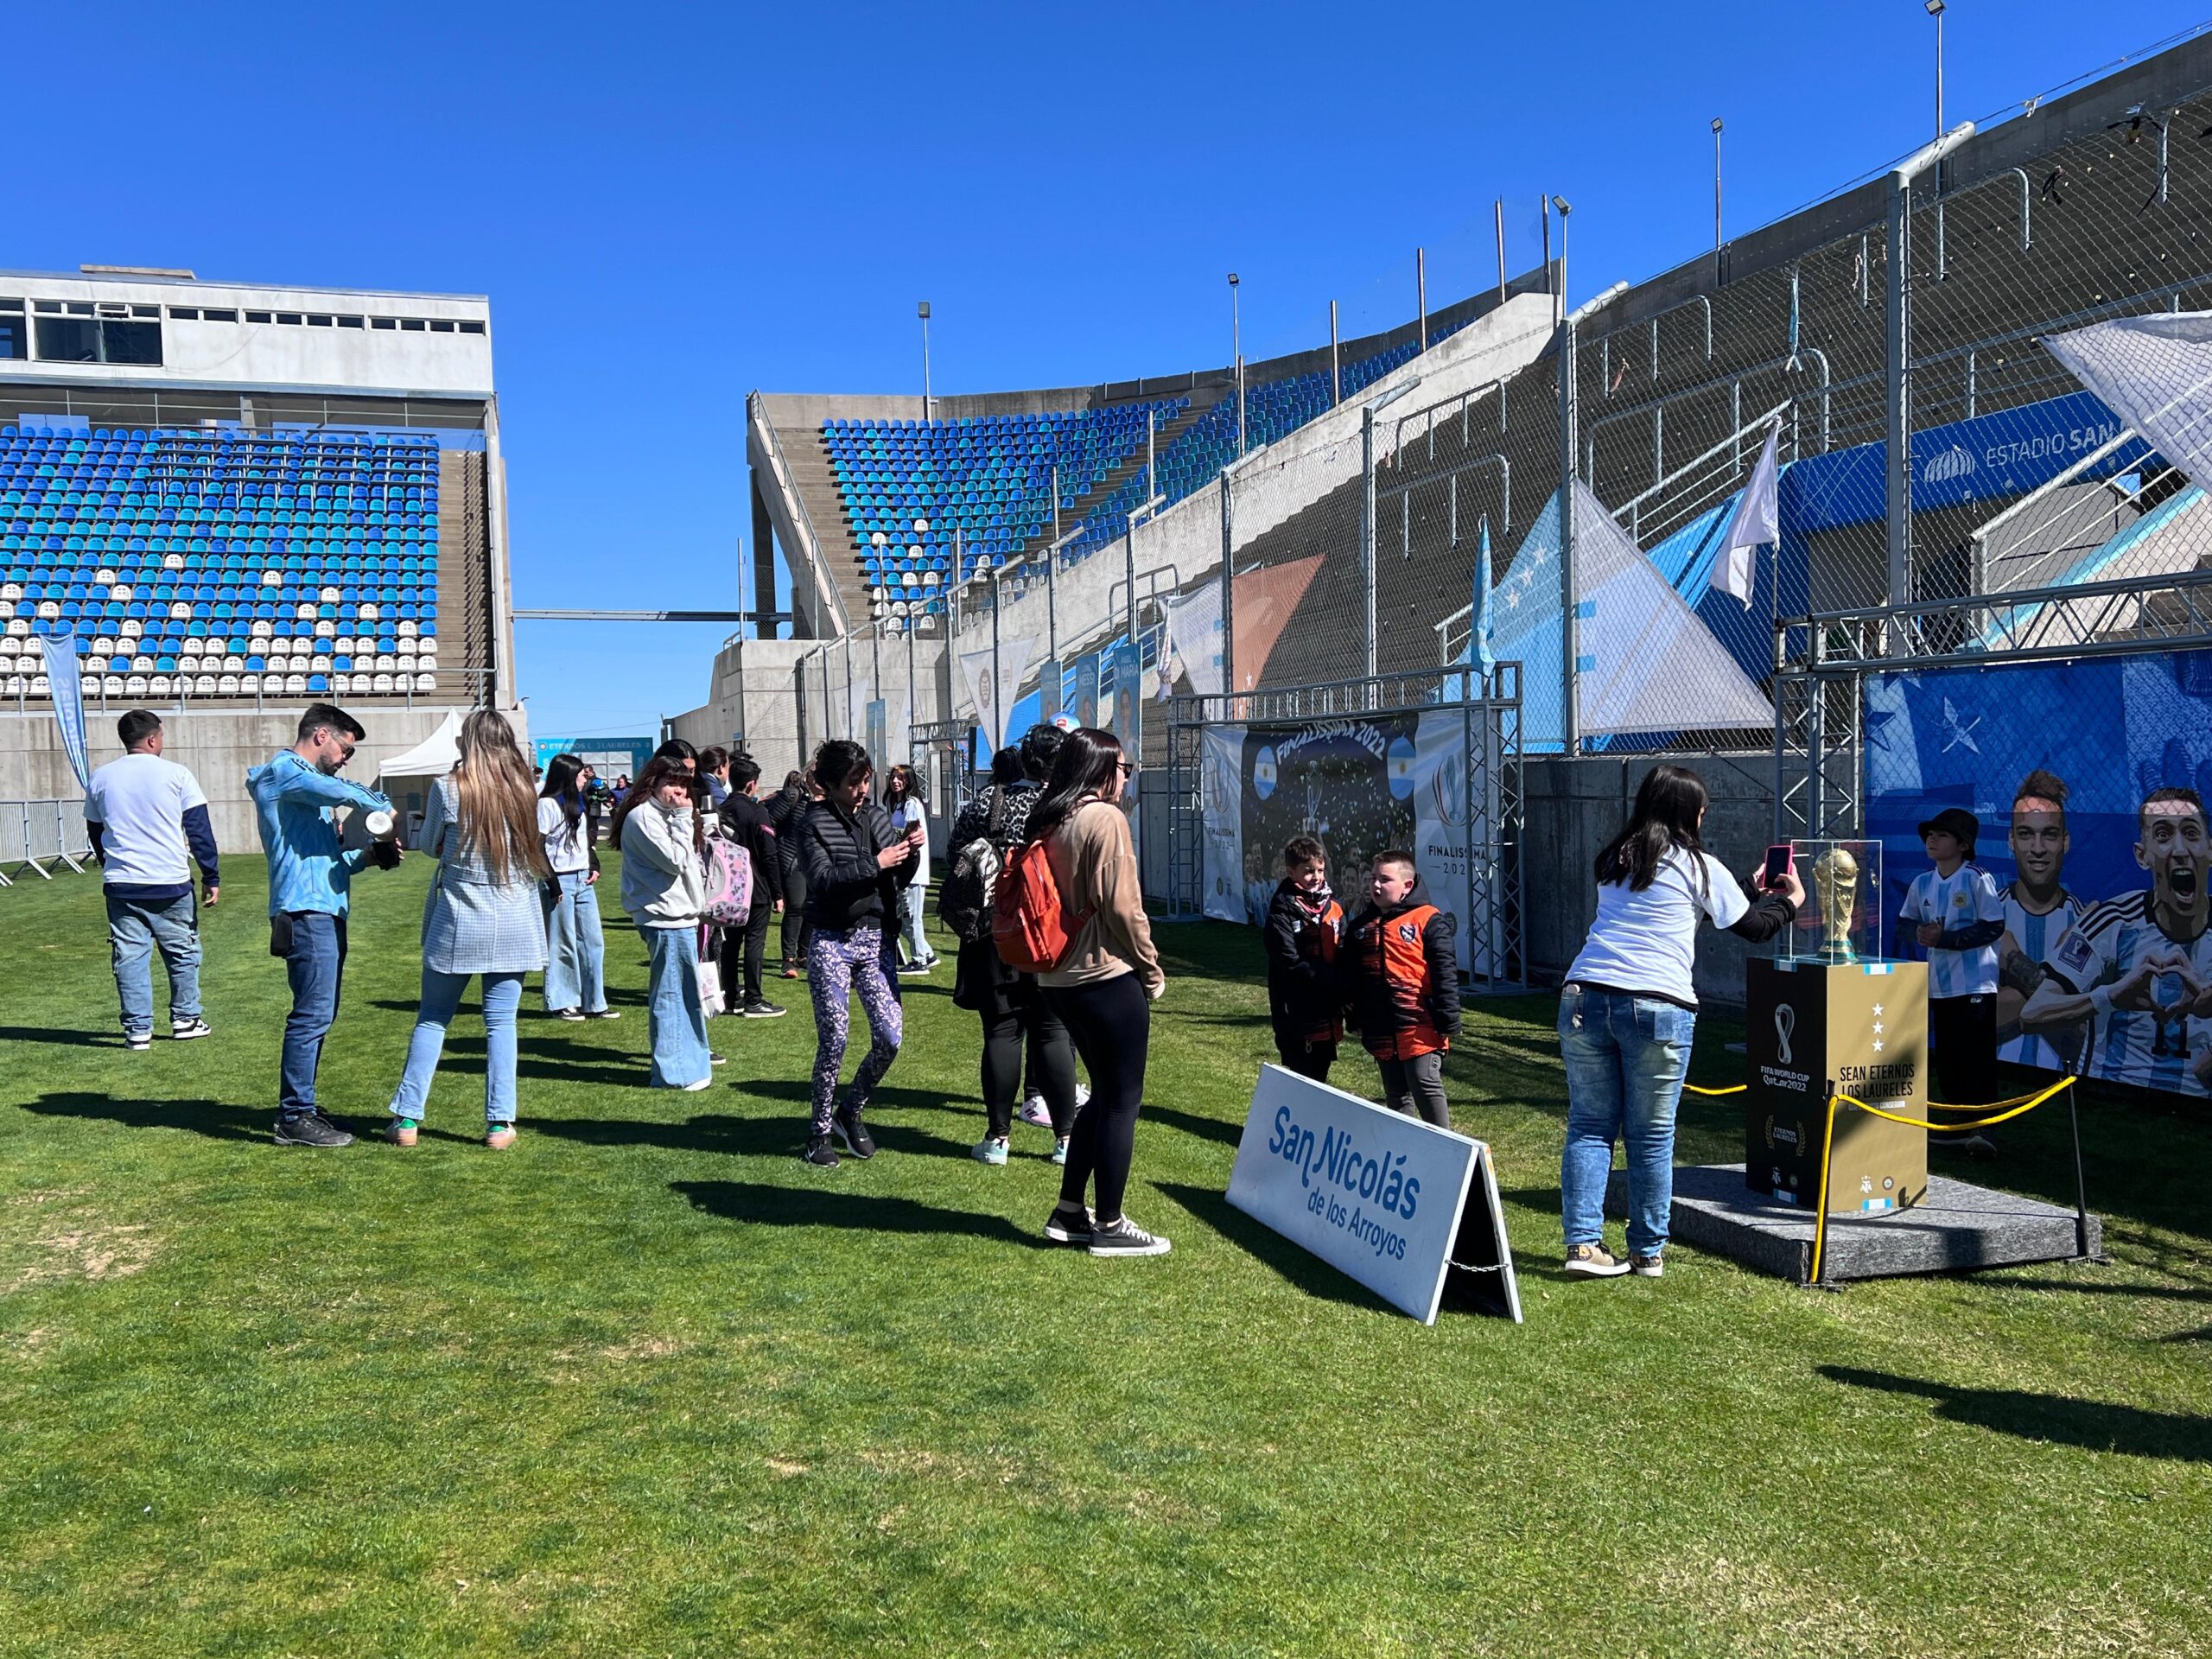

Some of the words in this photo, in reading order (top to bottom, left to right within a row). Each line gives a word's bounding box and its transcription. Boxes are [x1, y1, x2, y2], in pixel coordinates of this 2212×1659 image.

[1986, 433, 2065, 467] ESTADIO
[2069, 421, 2114, 451] SAN
[1276, 719, 1356, 766] FINALISSIMA
[1354, 721, 1386, 761] 2022
[1428, 845, 1487, 861] FINALISMA
[1443, 862, 1465, 875] 202
[1760, 1065, 1775, 1076] FIFA
[1774, 1068, 1797, 1080] WORLD
[1797, 1073, 1810, 1083] CUP
[1840, 1065, 1866, 1082] SEAN
[1869, 1063, 1915, 1080] ETERNOS
[1841, 1084, 1860, 1099] LOS
[1863, 1081, 1913, 1098] LAURELES
[1269, 1105, 1315, 1189] San
[1312, 1125, 1421, 1221] Nicolás
[1307, 1186, 1325, 1217] de
[1325, 1193, 1348, 1229] los
[1347, 1206, 1407, 1262] Arroyos
